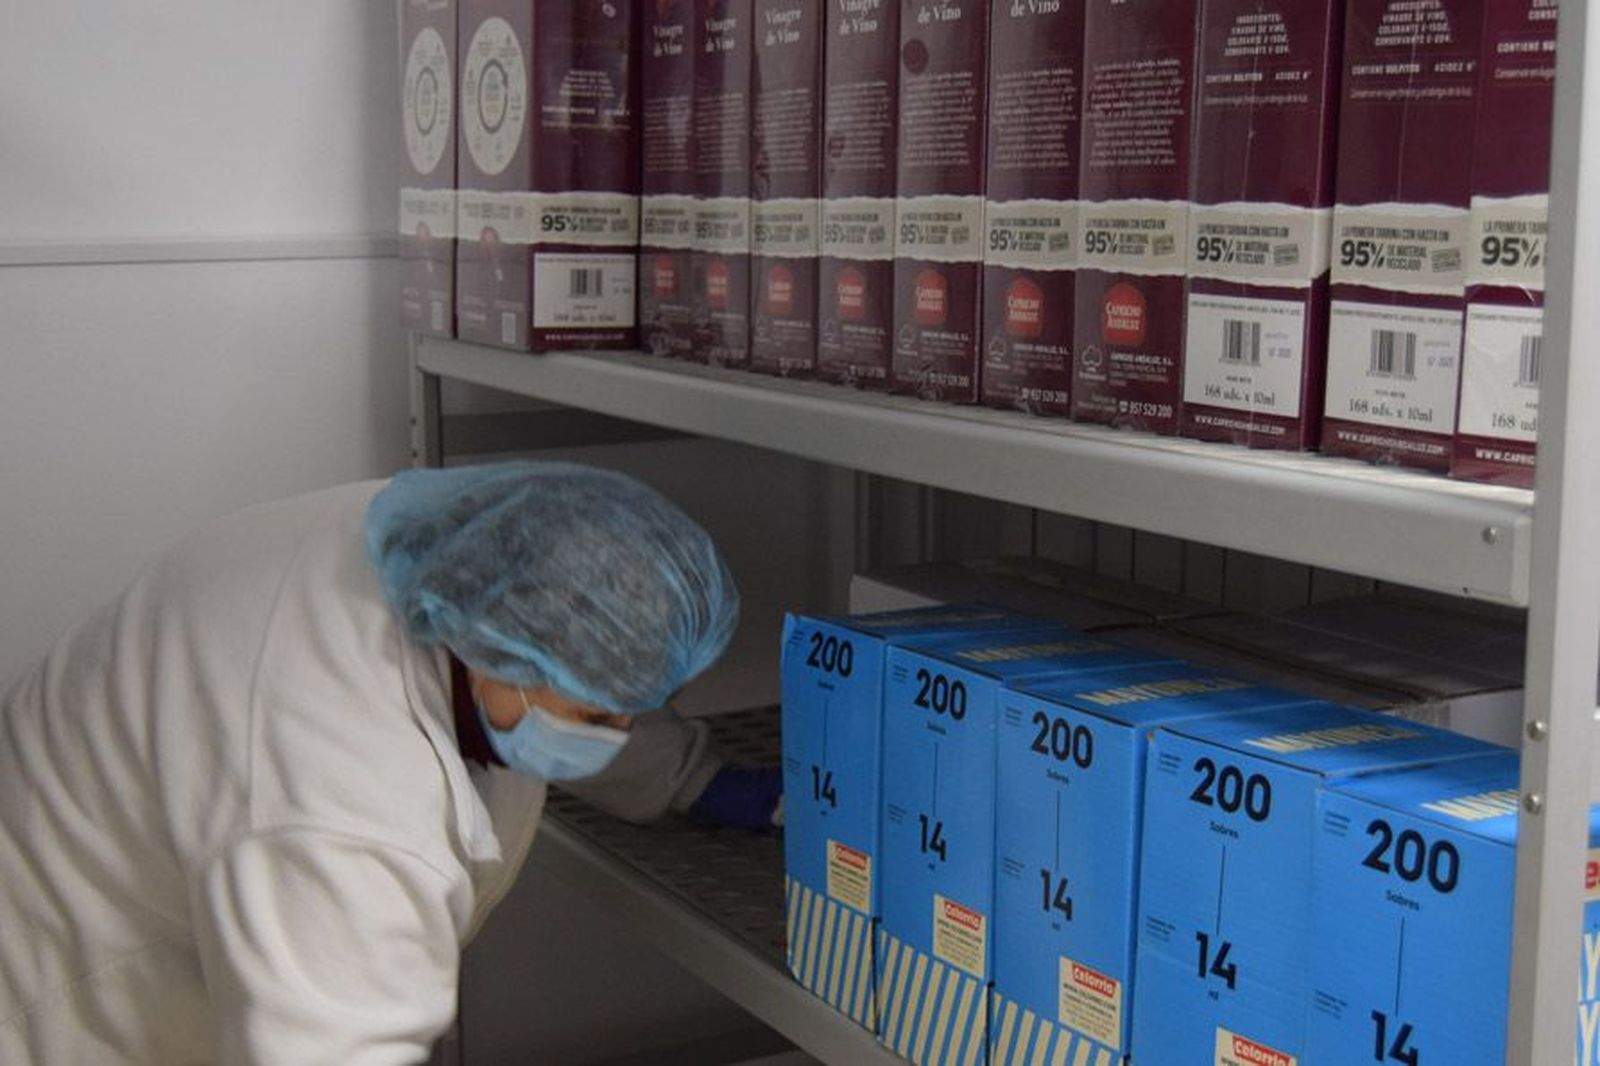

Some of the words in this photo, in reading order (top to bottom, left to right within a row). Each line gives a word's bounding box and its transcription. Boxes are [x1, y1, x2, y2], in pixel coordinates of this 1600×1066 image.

[933, 3, 962, 21] Vino
[1028, 0, 1060, 14] Vino
[541, 213, 579, 232] 95%
[1085, 230, 1117, 255] 95%
[1197, 236, 1234, 263] 95%
[1341, 239, 1385, 268] 95%
[1481, 235, 1540, 268] 95%
[1204, 383, 1221, 398] 168
[1253, 391, 1276, 405] 10ml
[1349, 398, 1369, 413] 168
[1407, 406, 1434, 423] 10ml
[1491, 412, 1516, 429] 168
[806, 630, 854, 678] 200
[914, 667, 967, 720] 200
[1031, 710, 1094, 769] 200
[811, 764, 837, 809] 14
[1189, 756, 1272, 823] 200
[919, 813, 946, 862] 14
[1209, 820, 1239, 840] Sobres
[1361, 818, 1460, 894] 200
[1040, 868, 1074, 922] 14
[1386, 890, 1420, 911] Sobres
[1195, 930, 1237, 990] 14
[1371, 1009, 1418, 1066] 14
